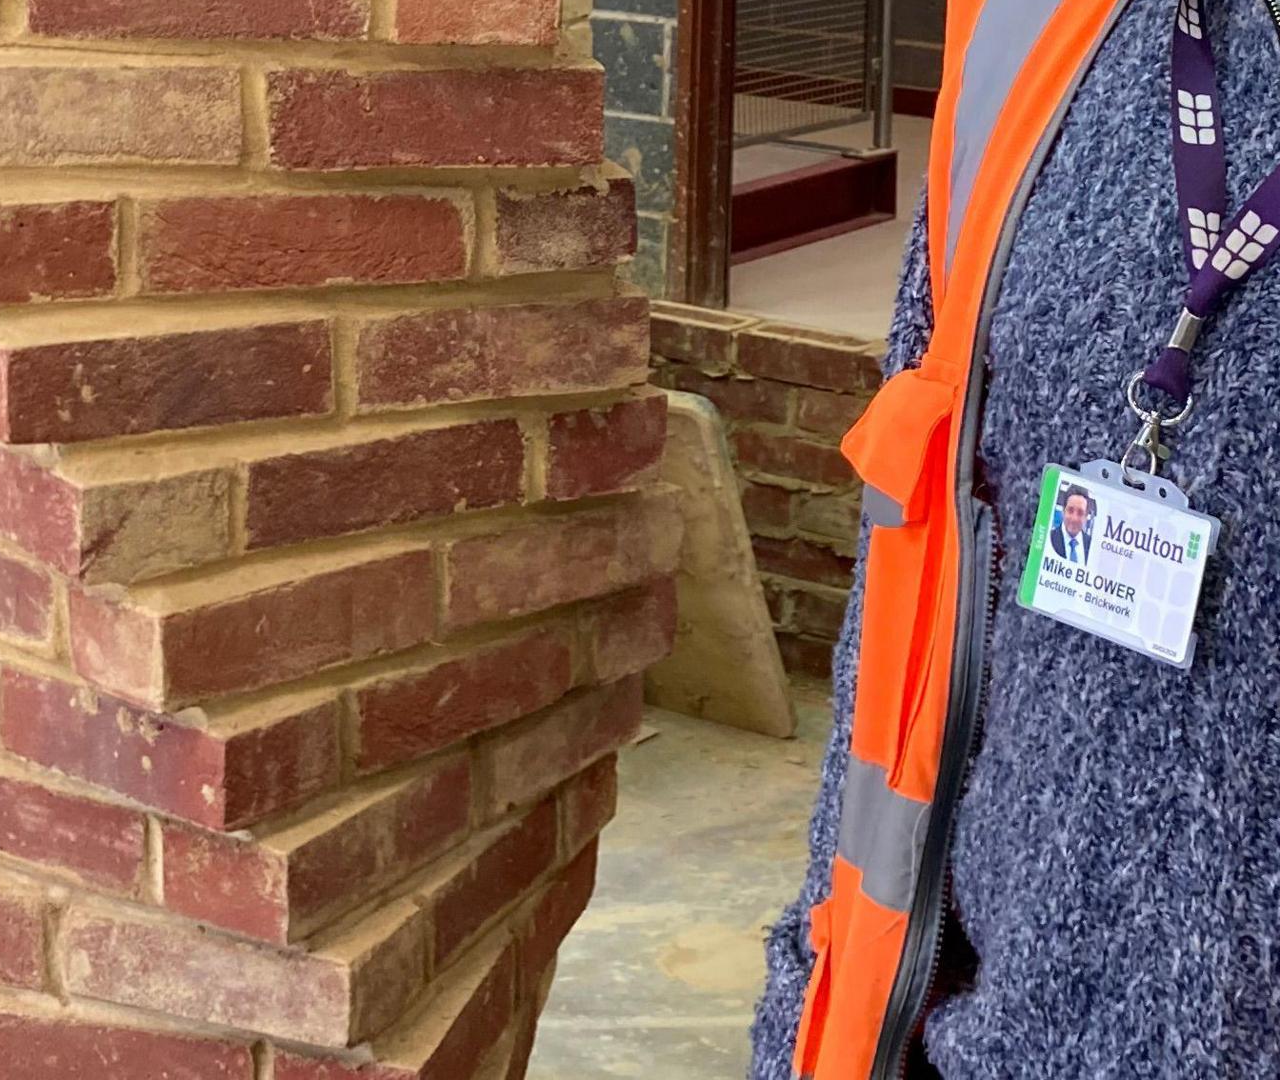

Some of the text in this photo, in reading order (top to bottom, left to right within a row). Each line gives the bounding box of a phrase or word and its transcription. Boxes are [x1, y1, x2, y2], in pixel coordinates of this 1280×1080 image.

[1101, 540, 1134, 560] COLLEGE
[1103, 515, 1184, 564] Moulton
[1039, 576, 1077, 598] Lecturer
[1084, 591, 1131, 618] Brickwork
[1042, 556, 1136, 603] Mike BLOWER
